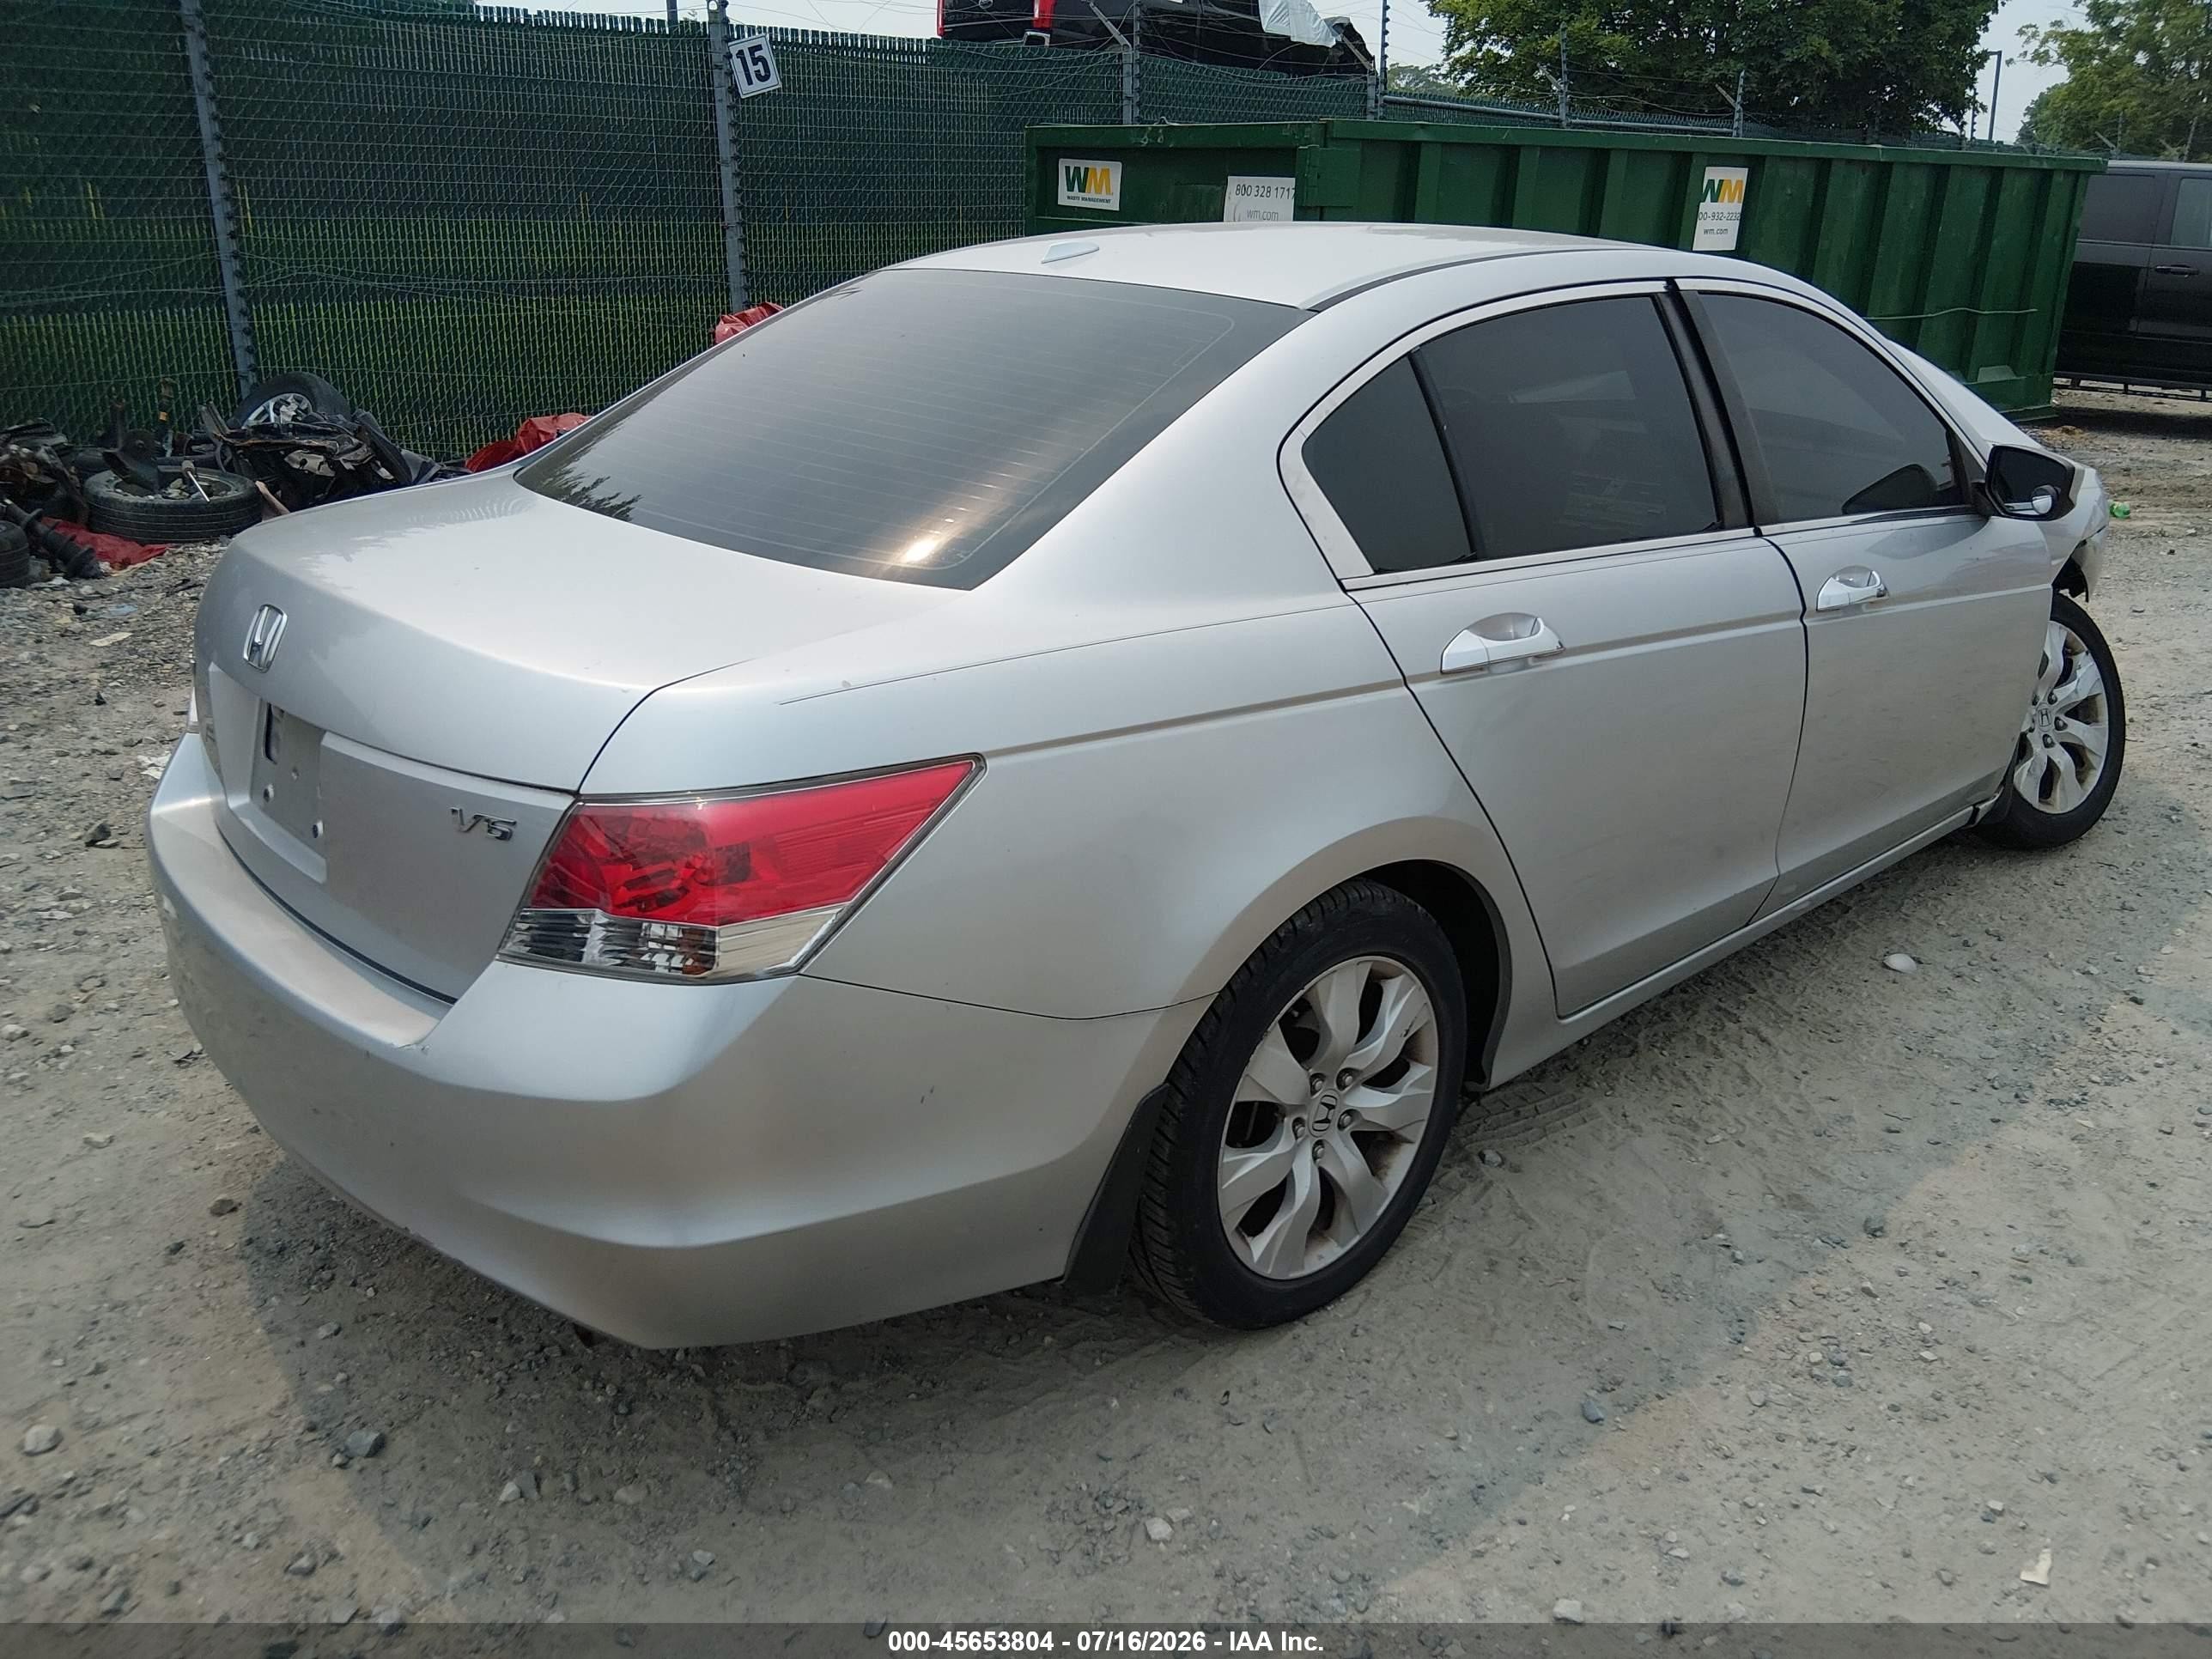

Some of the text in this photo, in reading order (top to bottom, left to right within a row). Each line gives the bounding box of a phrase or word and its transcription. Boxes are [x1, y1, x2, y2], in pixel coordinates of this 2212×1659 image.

[736, 44, 771, 86] 15
[1065, 165, 1113, 195] WM
[1235, 184, 1253, 197] 800
[1254, 185, 1272, 198] 328
[1081, 196, 1112, 204] MANAGEMENT
[1246, 209, 1279, 222] wm.com
[449, 806, 518, 842] V6
